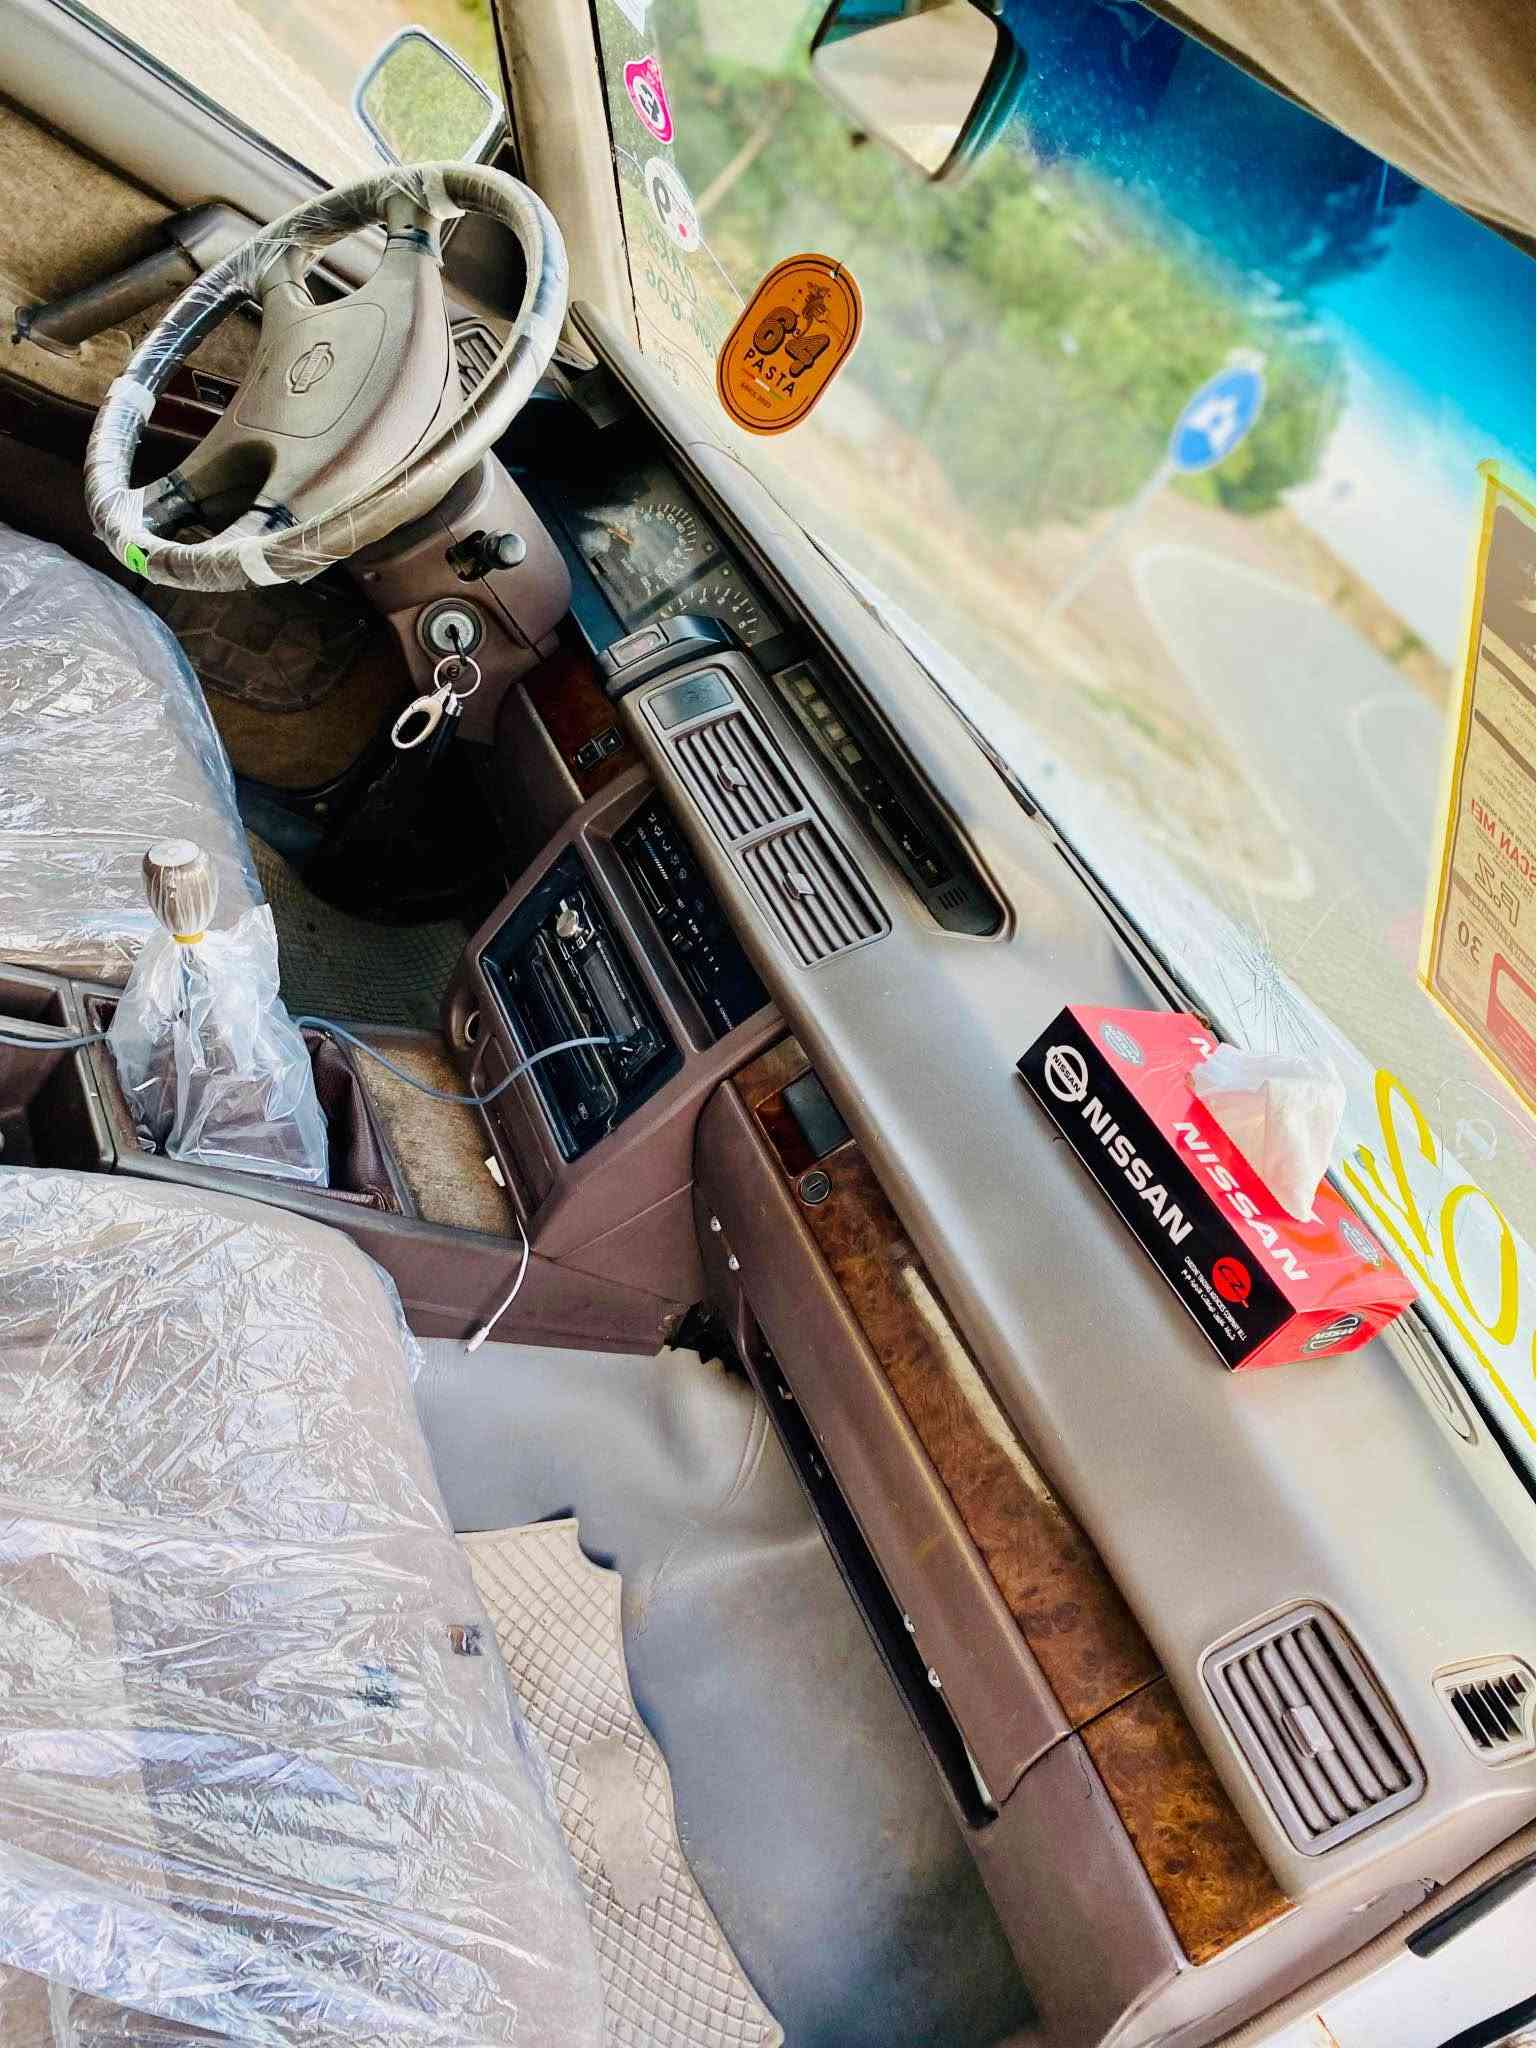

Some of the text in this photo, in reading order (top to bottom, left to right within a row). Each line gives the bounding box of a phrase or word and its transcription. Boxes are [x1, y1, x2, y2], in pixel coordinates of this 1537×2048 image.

[744, 349, 796, 398] PASTA
[1051, 1054, 1083, 1095] NISSAN
[1081, 1096, 1194, 1247] NISSAN
[1173, 1122, 1310, 1281] NISSAN
